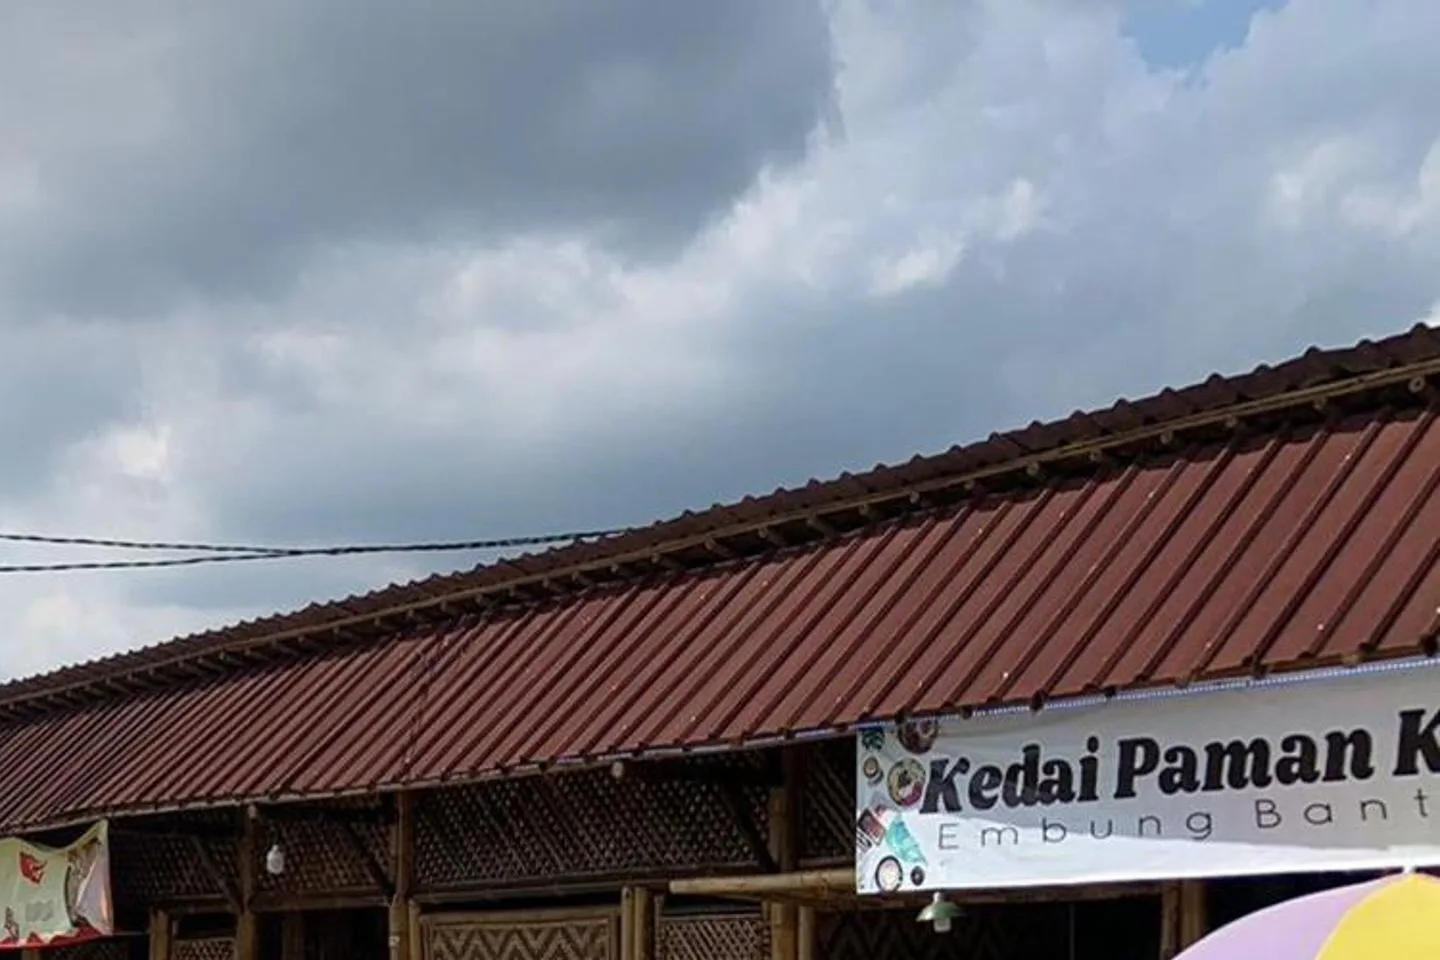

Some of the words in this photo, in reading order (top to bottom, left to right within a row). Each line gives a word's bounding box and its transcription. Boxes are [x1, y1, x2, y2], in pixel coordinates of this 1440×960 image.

[919, 736, 1100, 815] Kedai
[1113, 724, 1375, 800] Paman
[938, 811, 1213, 851] Embung
[1255, 788, 1428, 829] Bant
